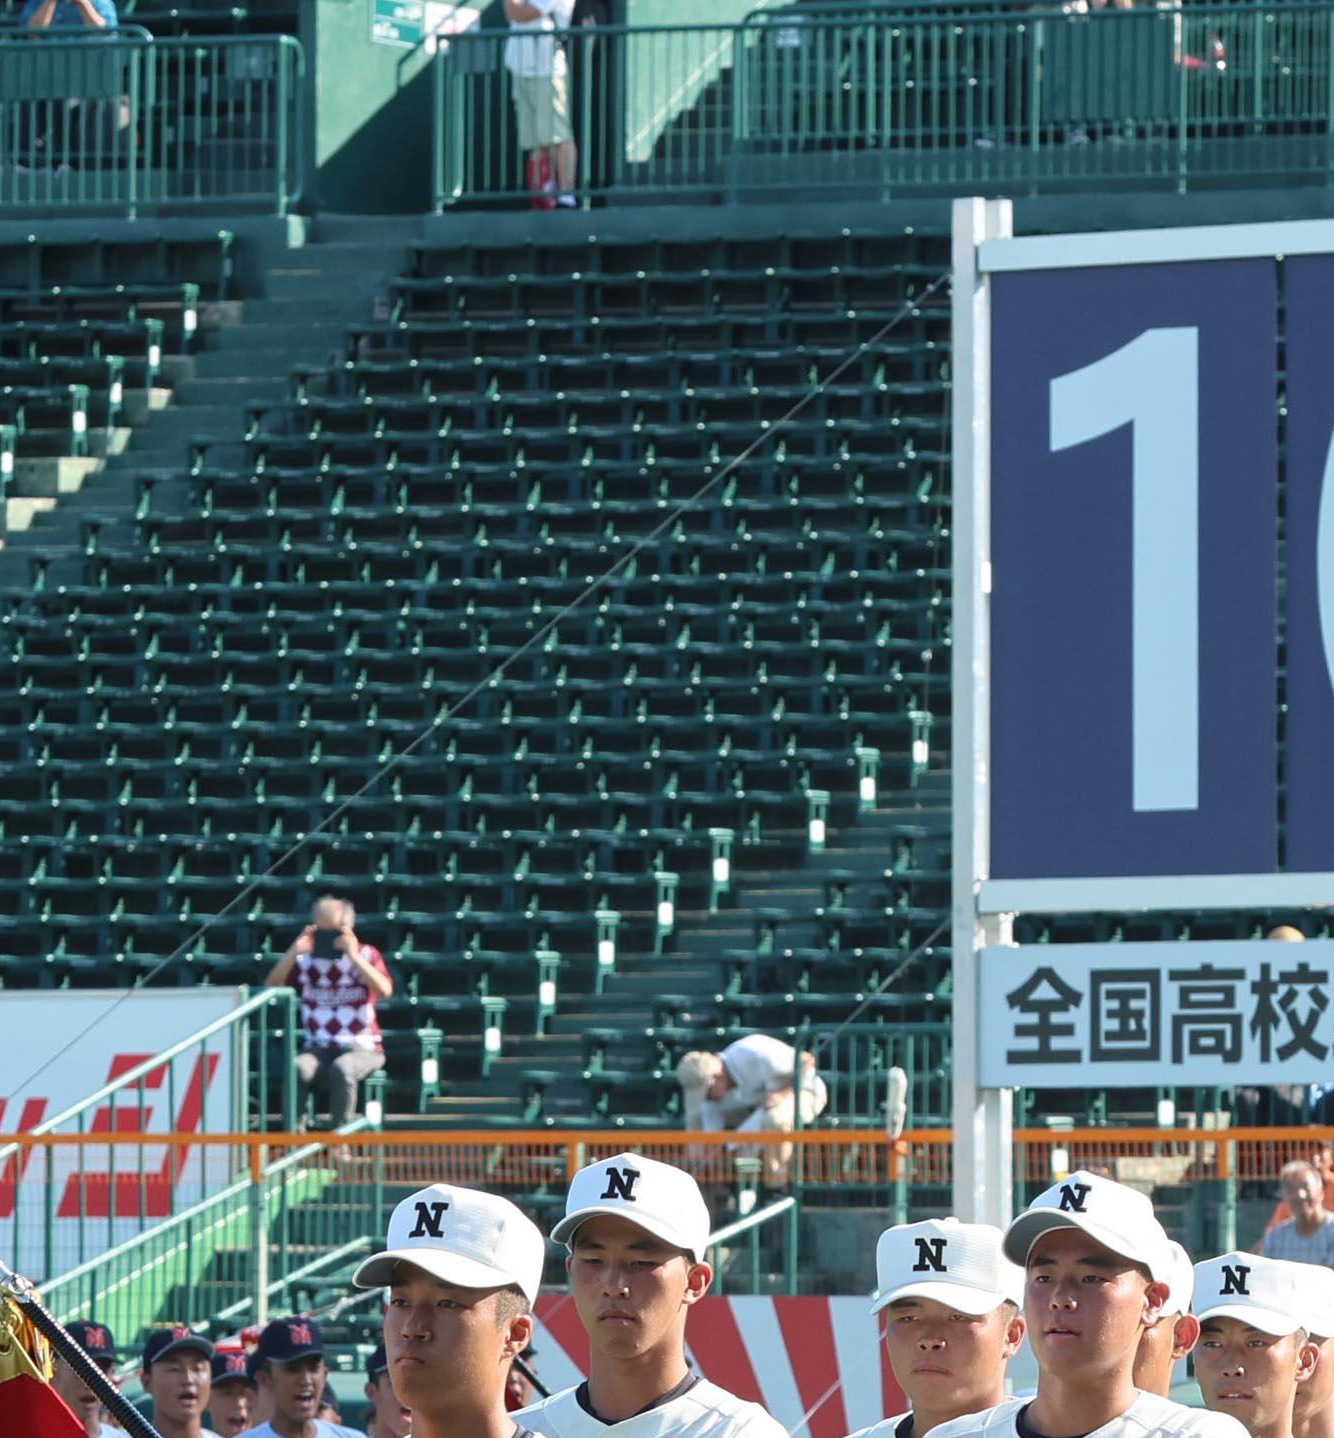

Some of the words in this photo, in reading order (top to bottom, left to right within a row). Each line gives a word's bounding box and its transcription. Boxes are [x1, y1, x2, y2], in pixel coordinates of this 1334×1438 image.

[601, 1168, 639, 1201] N
[1059, 1184, 1091, 1213] N
[408, 1202, 449, 1238] N
[913, 1238, 947, 1272] N
[1220, 1265, 1250, 1295] N
